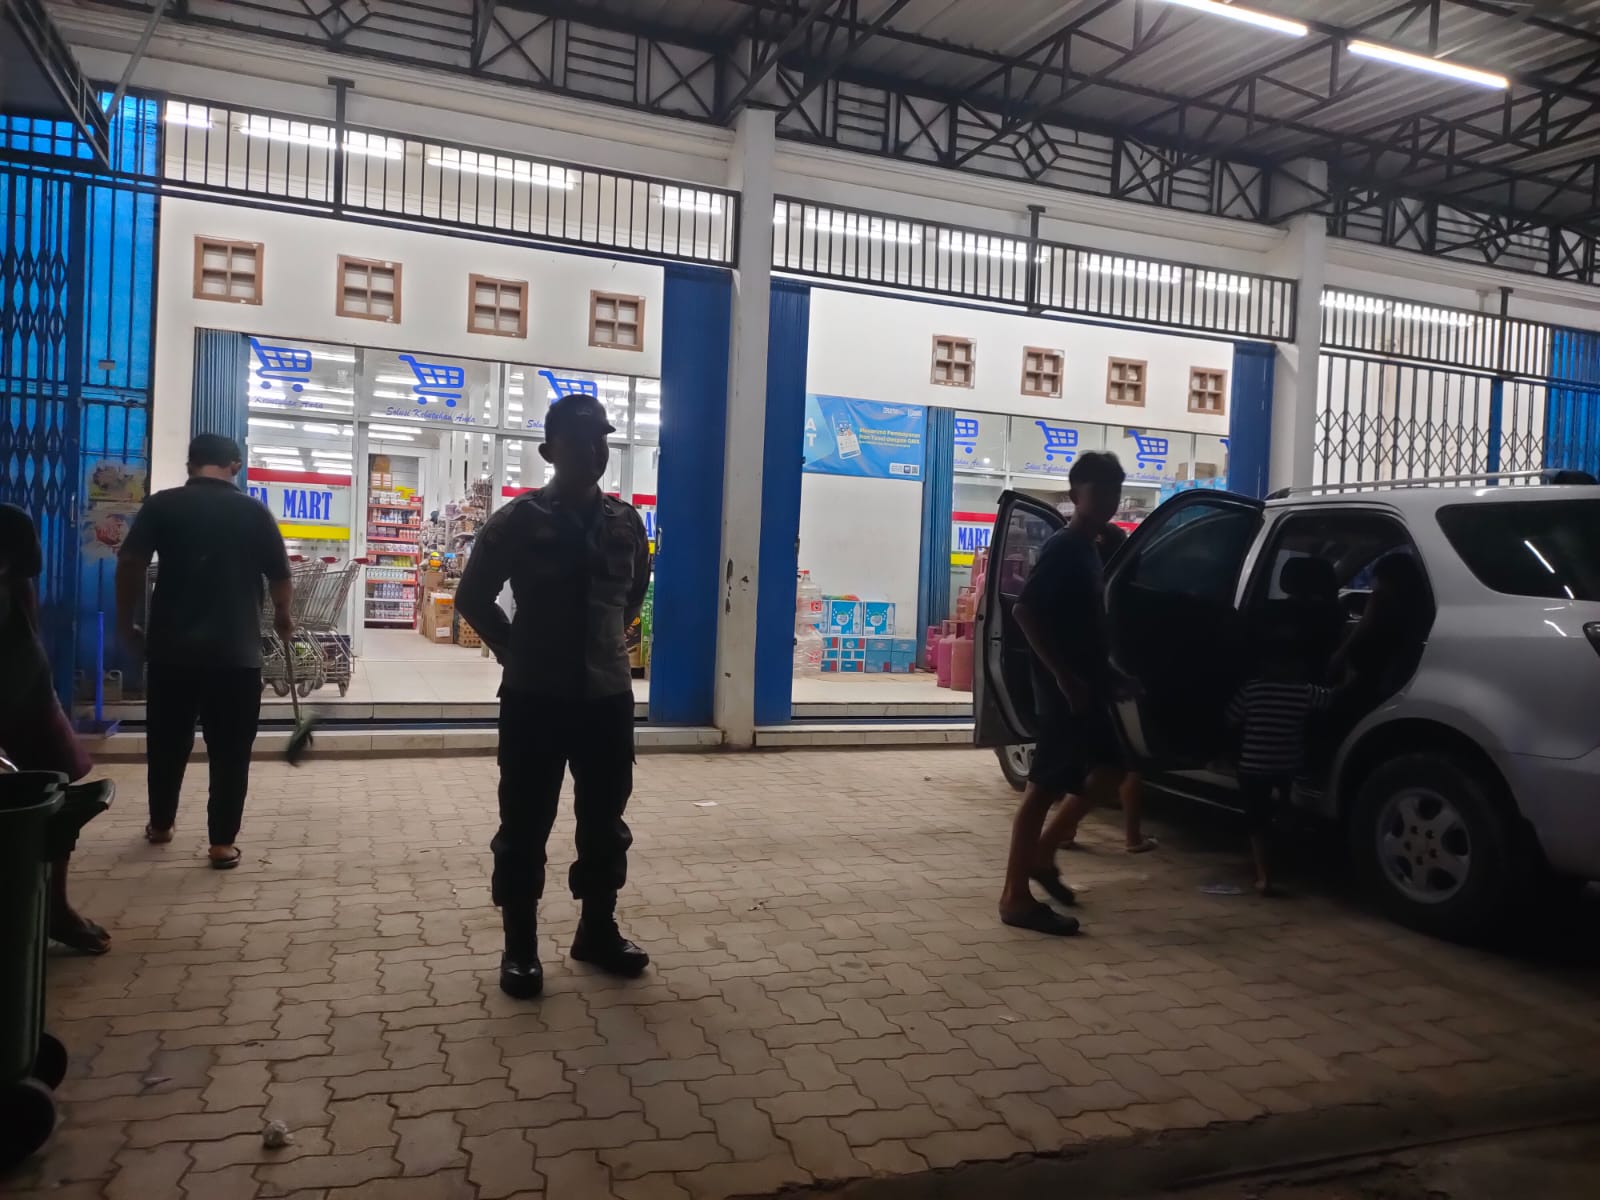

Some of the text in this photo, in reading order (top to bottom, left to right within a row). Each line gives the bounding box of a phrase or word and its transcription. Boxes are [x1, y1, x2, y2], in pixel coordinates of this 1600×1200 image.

[386, 406, 476, 423] Solusi Kebutuhan Anda
[283, 489, 333, 521] MART
[958, 526, 991, 551] MART
